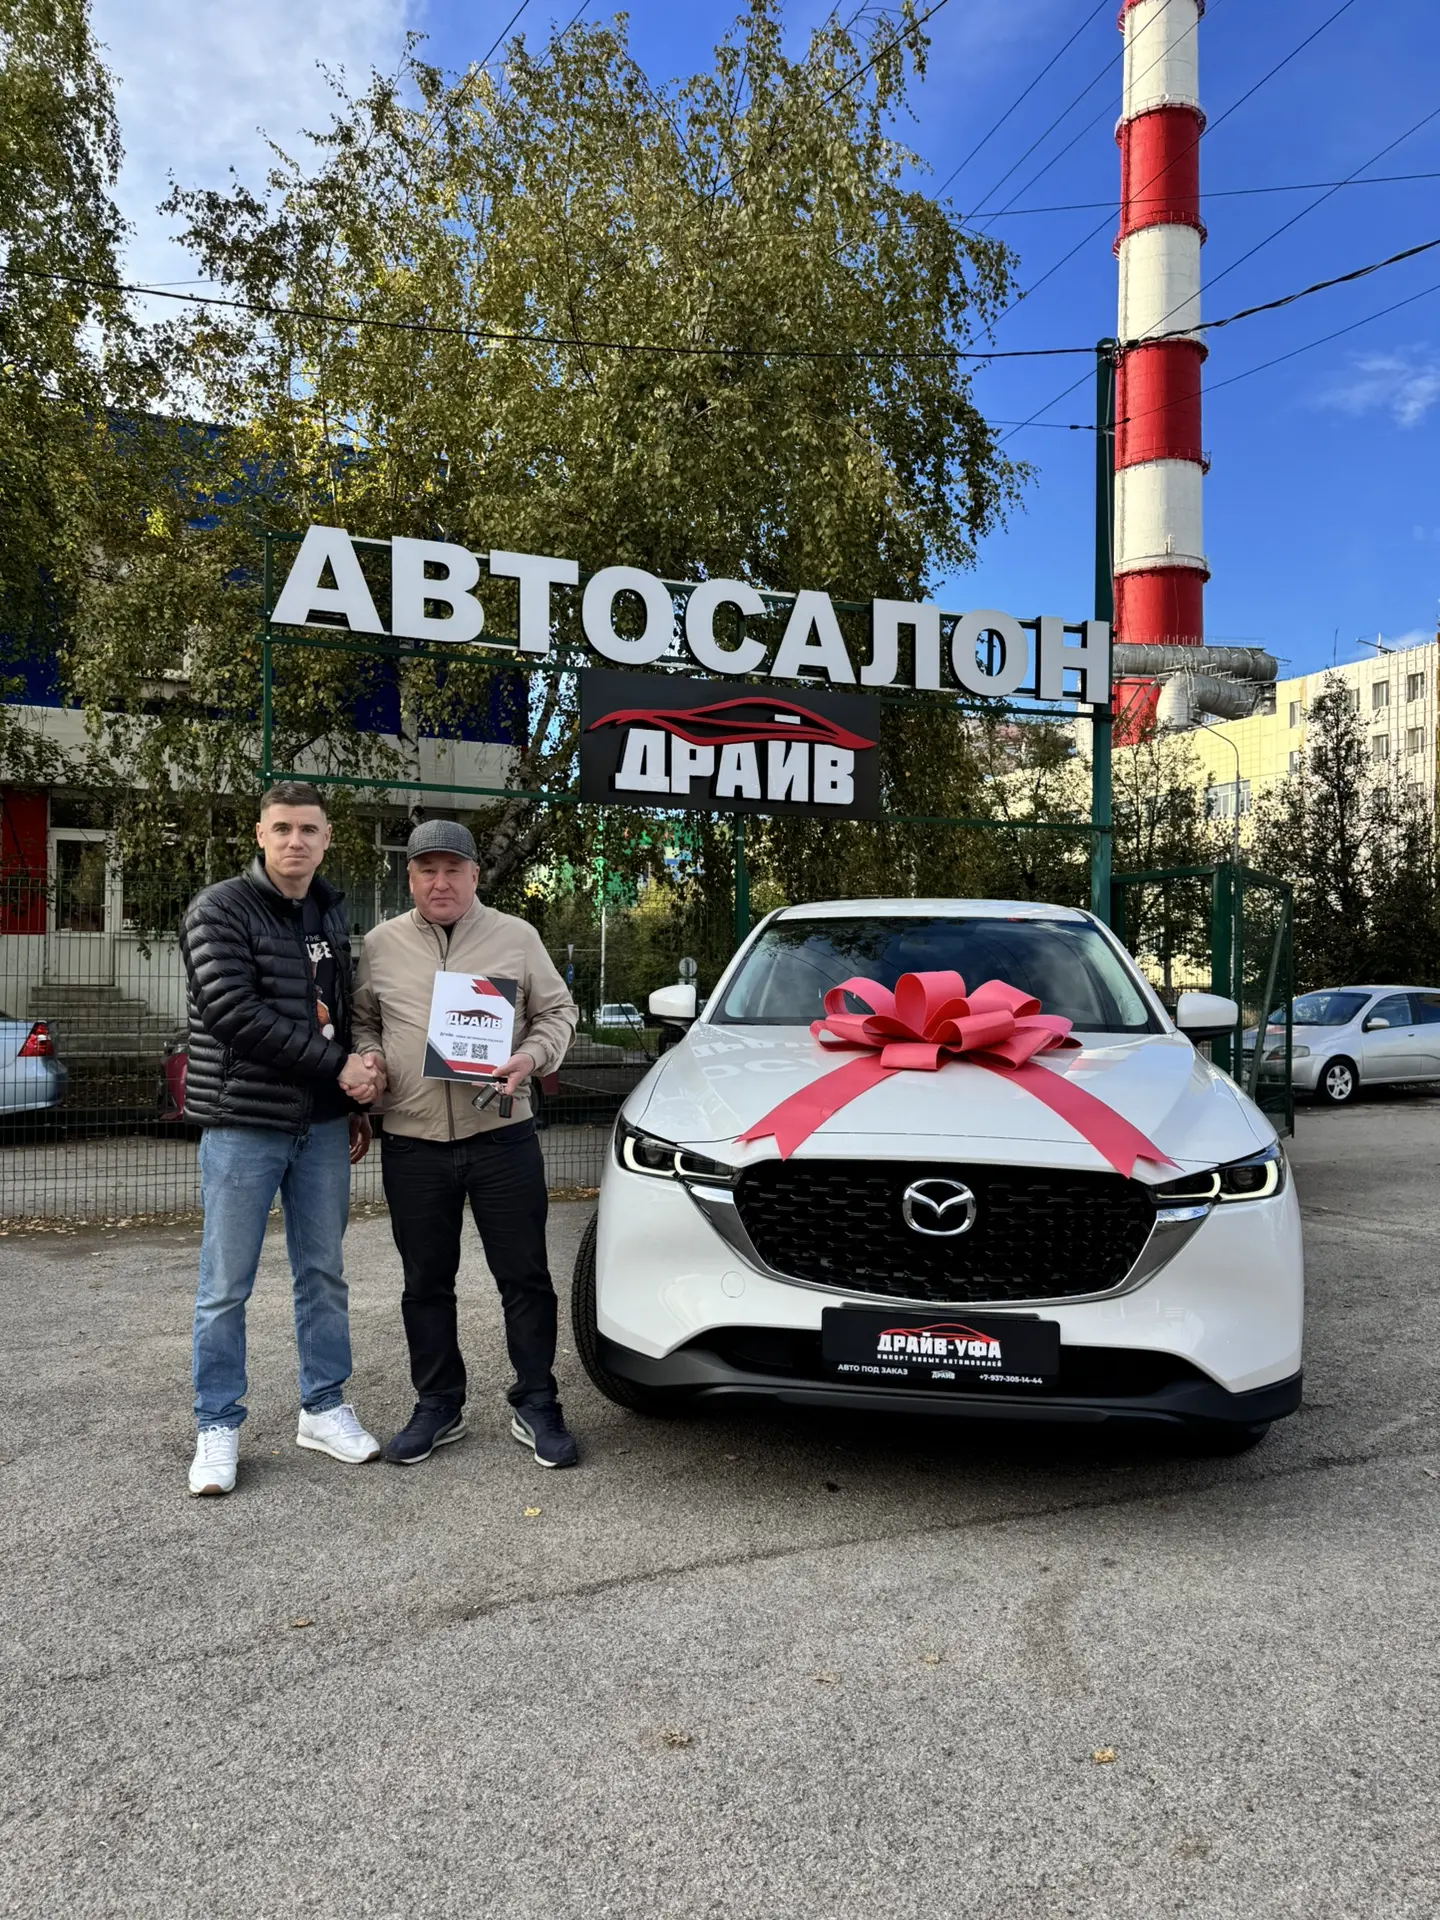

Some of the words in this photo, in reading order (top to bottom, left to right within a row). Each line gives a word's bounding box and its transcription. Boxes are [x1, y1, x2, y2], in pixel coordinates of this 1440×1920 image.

[270, 525, 1111, 703] АВТОСАЛОН
[615, 716, 856, 805] ДРАЙВ
[446, 1011, 502, 1029] ДРАЙВ
[877, 1332, 1001, 1359] ДРАЙВ-УФА
[837, 1363, 860, 1372] АВТО
[861, 1365, 880, 1374] ПОД
[881, 1366, 908, 1376] ЗАКАЗ
[979, 1374, 1043, 1384] +7-937-305-14-44
